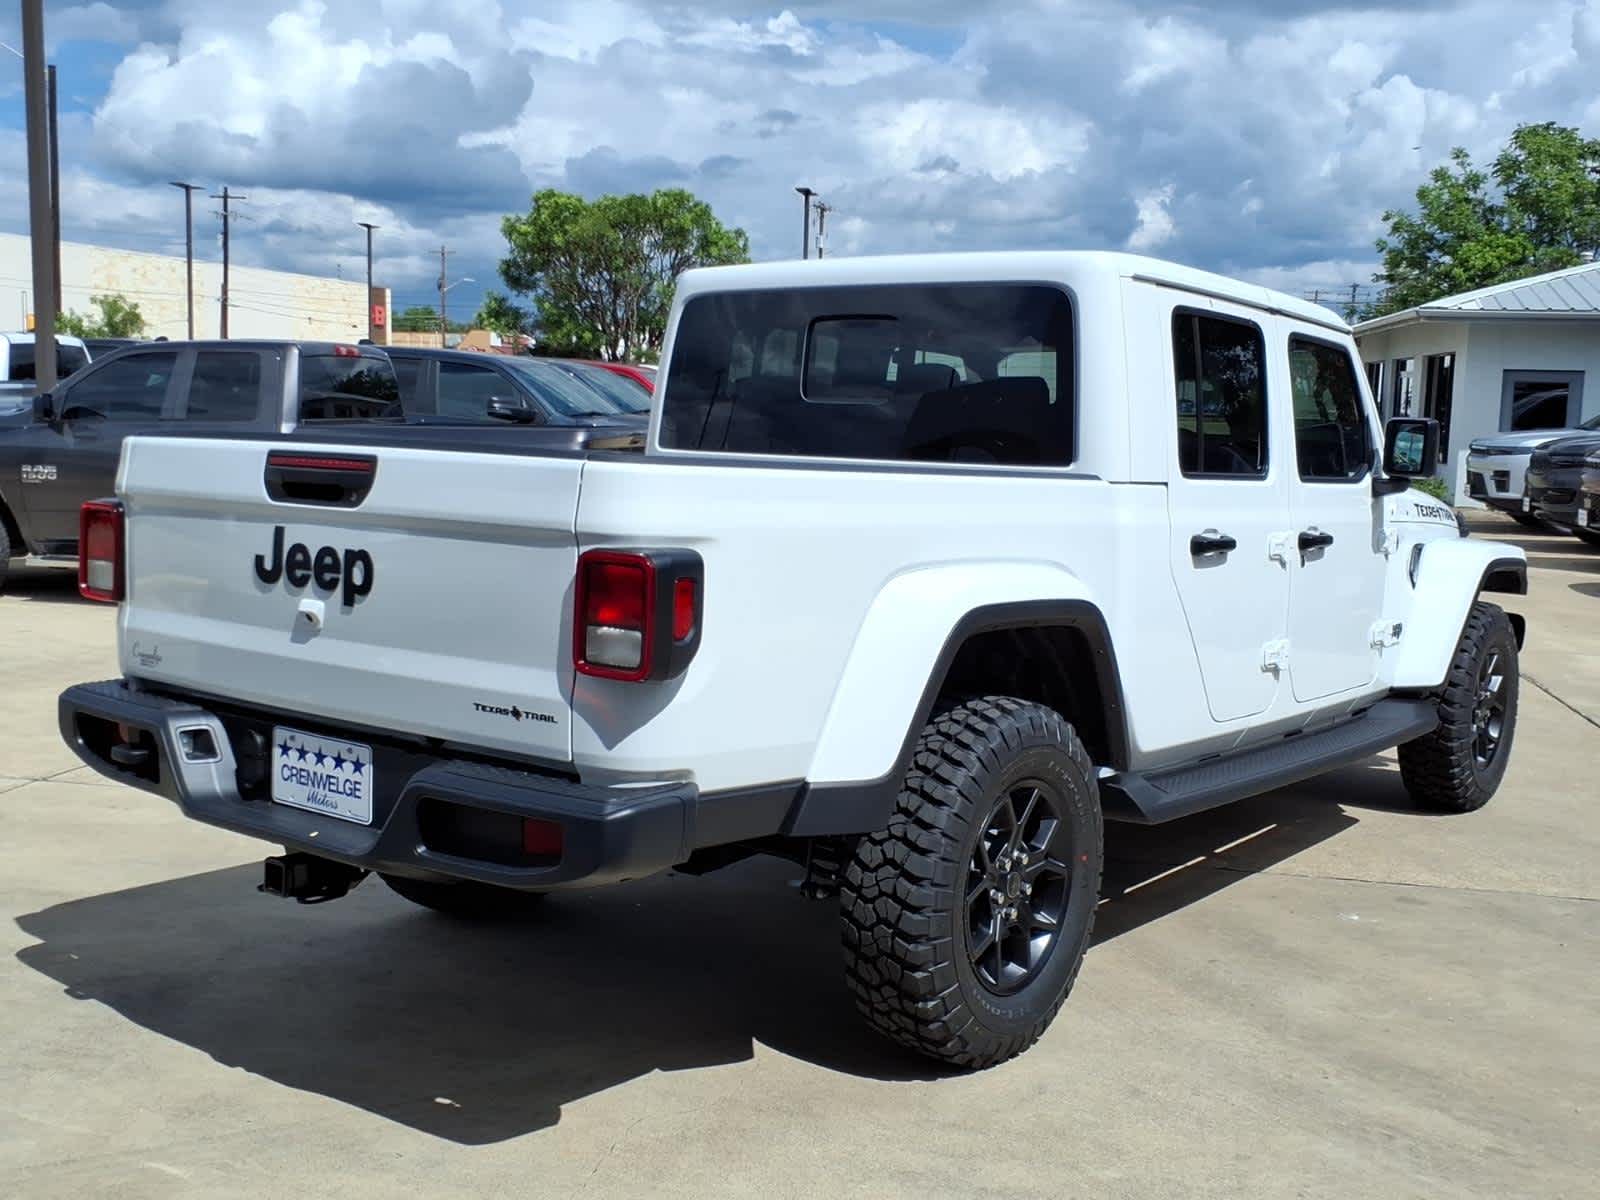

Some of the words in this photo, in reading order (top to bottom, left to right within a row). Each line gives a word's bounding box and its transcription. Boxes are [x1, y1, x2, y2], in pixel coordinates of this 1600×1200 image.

[255, 525, 374, 607] Jeep
[472, 702, 509, 715] TEXAS
[522, 710, 559, 724] TRAIL
[281, 763, 362, 799] CRENWELGE
